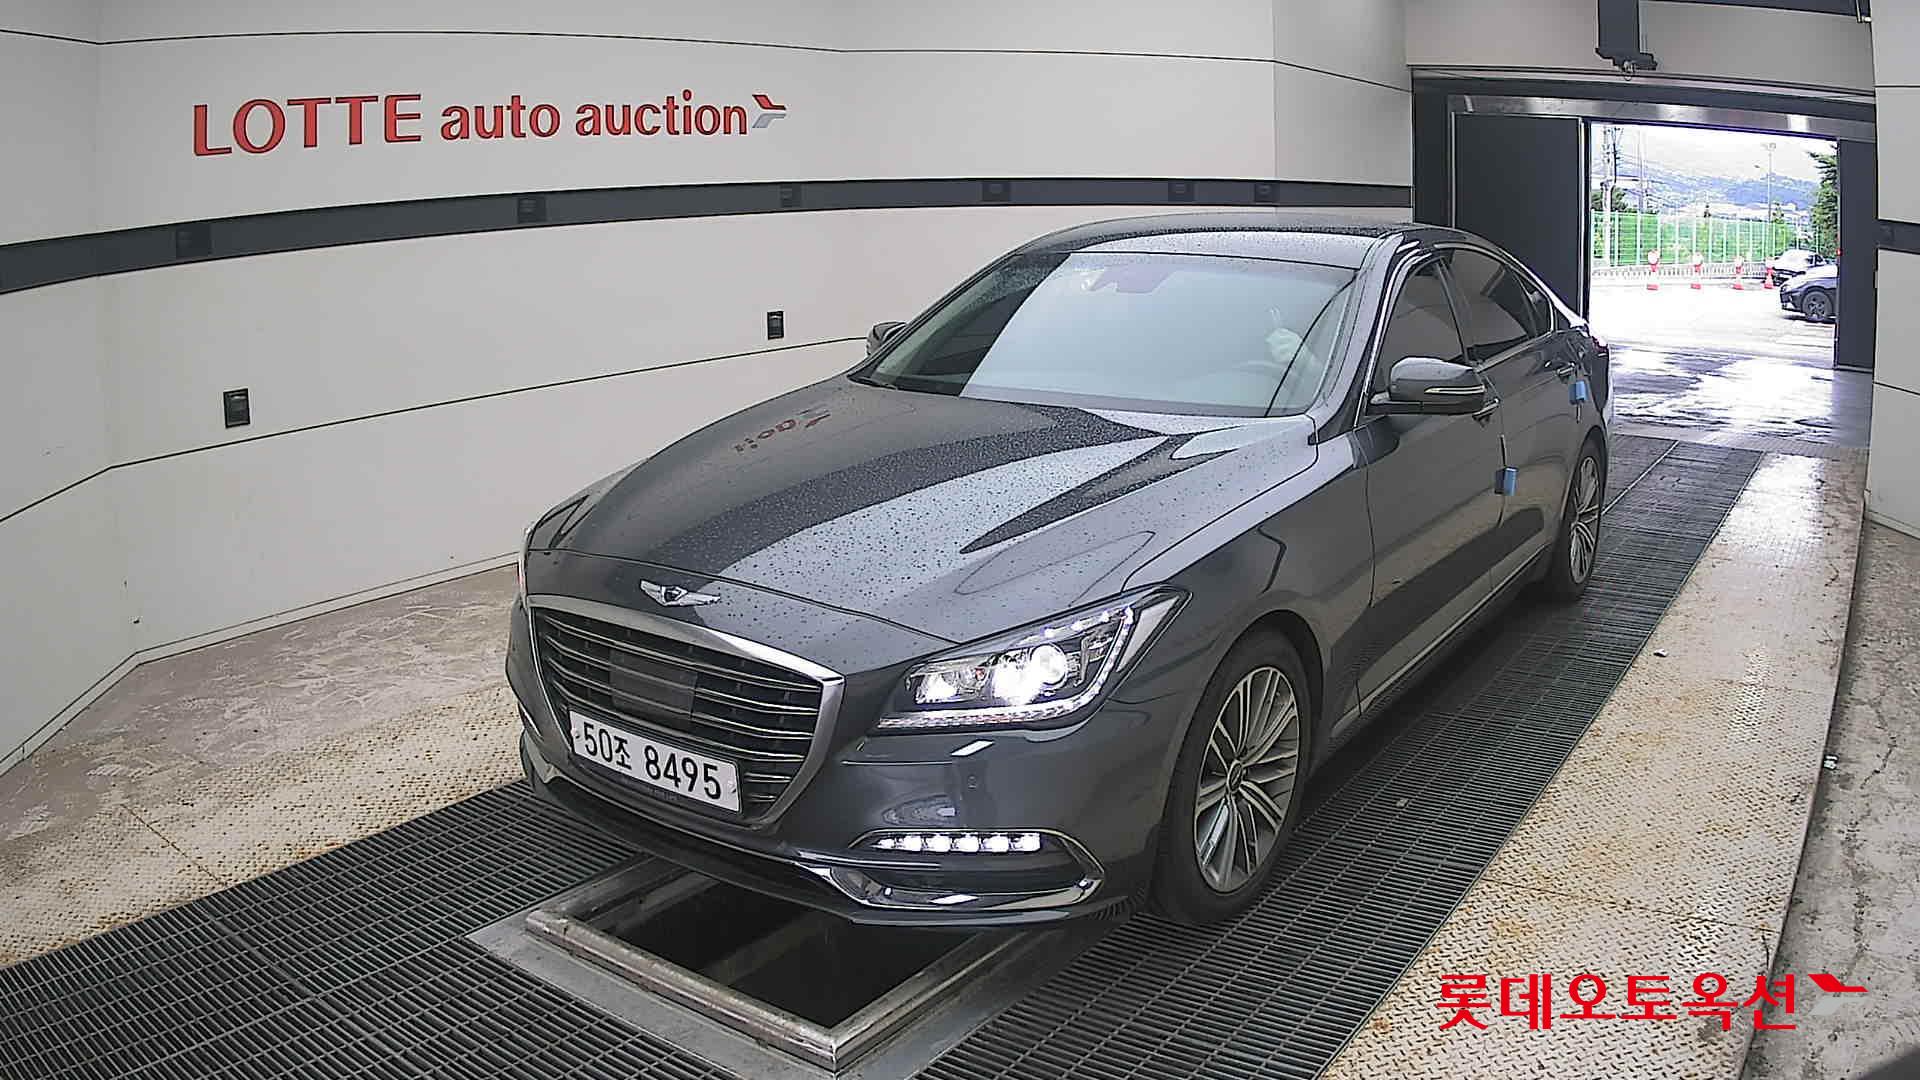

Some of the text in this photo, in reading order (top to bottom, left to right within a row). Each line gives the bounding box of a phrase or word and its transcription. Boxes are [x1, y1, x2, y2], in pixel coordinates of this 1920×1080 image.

[193, 89, 749, 156] LOTTE auto auction
[583, 721, 722, 800] 50조 8495
